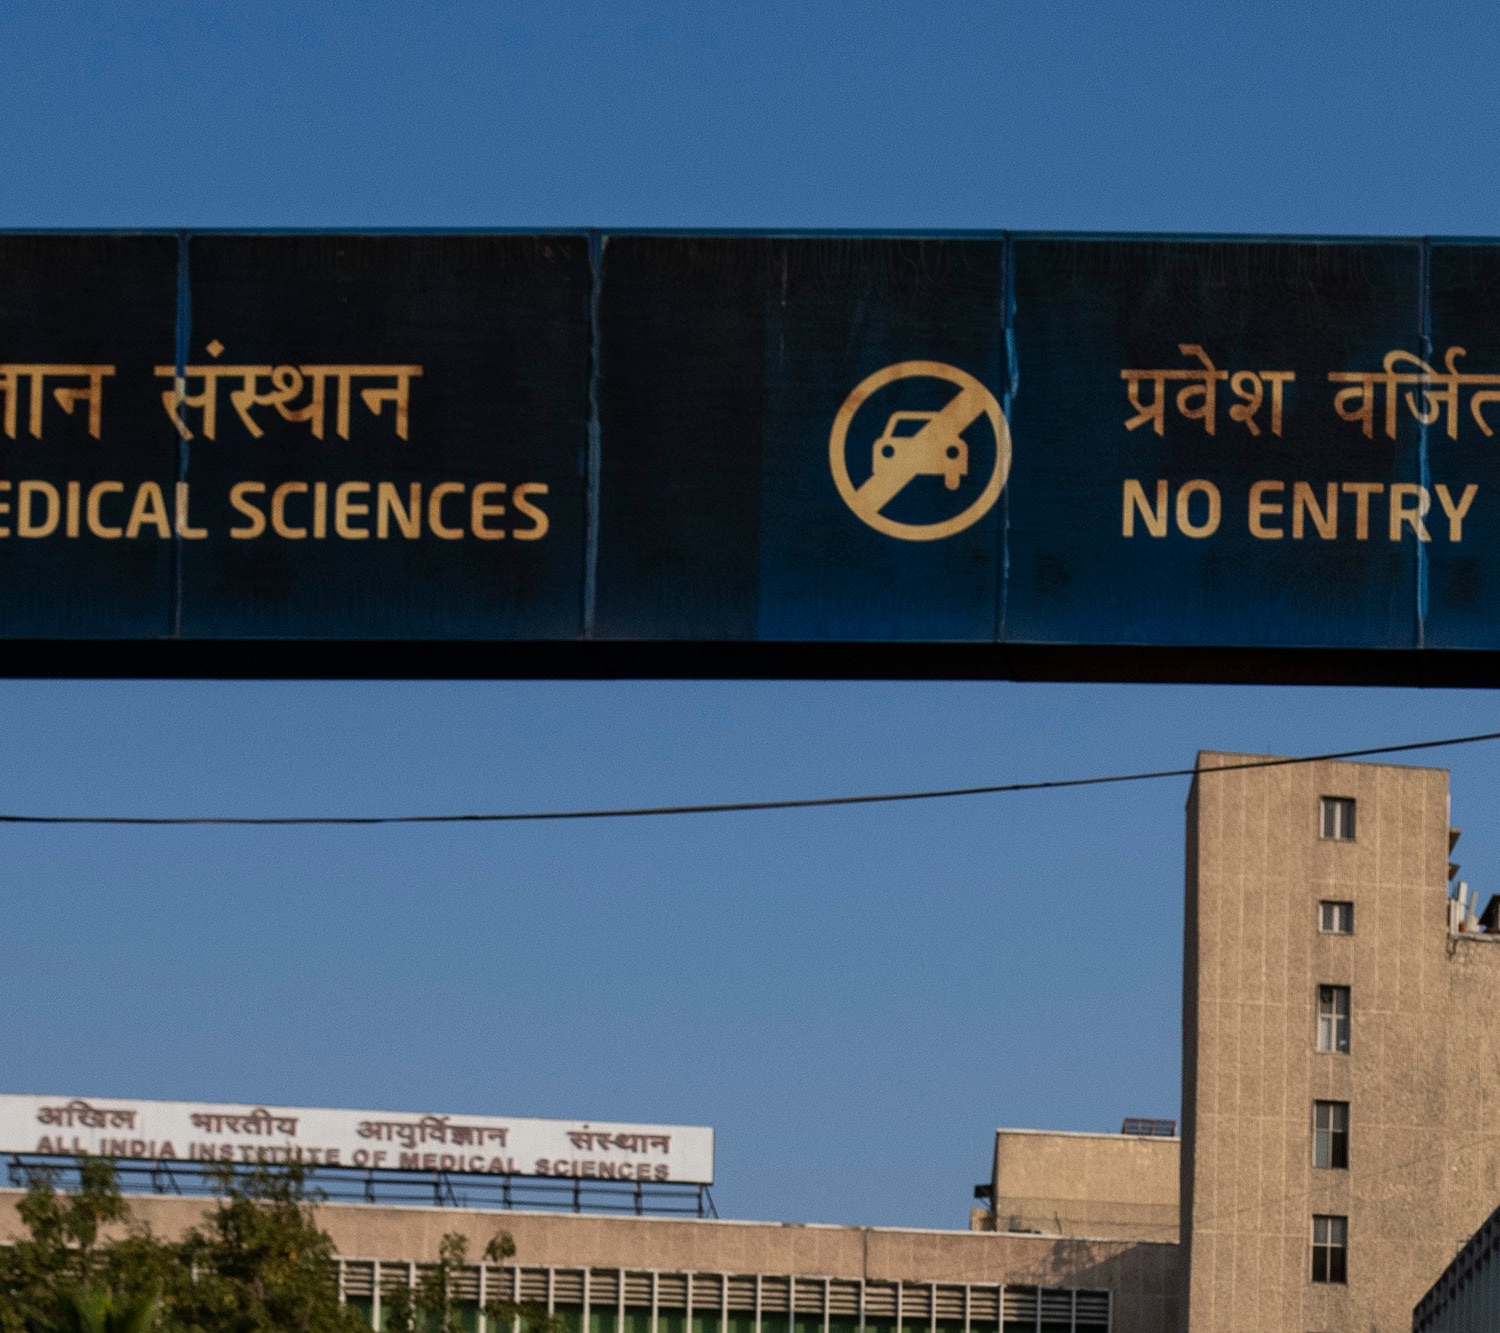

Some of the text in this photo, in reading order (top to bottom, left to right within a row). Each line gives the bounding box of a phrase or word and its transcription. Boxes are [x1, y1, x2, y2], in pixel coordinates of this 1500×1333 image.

[154, 340, 423, 442] संस्थान
[1120, 343, 1295, 444] प्रवेश
[227, 480, 552, 543] SCIENCES
[1120, 478, 1480, 544] NO ENTRY
[36, 1135, 88, 1155] ALL
[101, 1139, 177, 1159] INDIA
[353, 1149, 388, 1168] OF
[400, 1152, 522, 1174] MEDICAL
[536, 1158, 671, 1181] SCIENCES
[38, 1100, 137, 1129] अखिल
[191, 1106, 299, 1136] भारतीय
[567, 1125, 671, 1154] संस्थान
